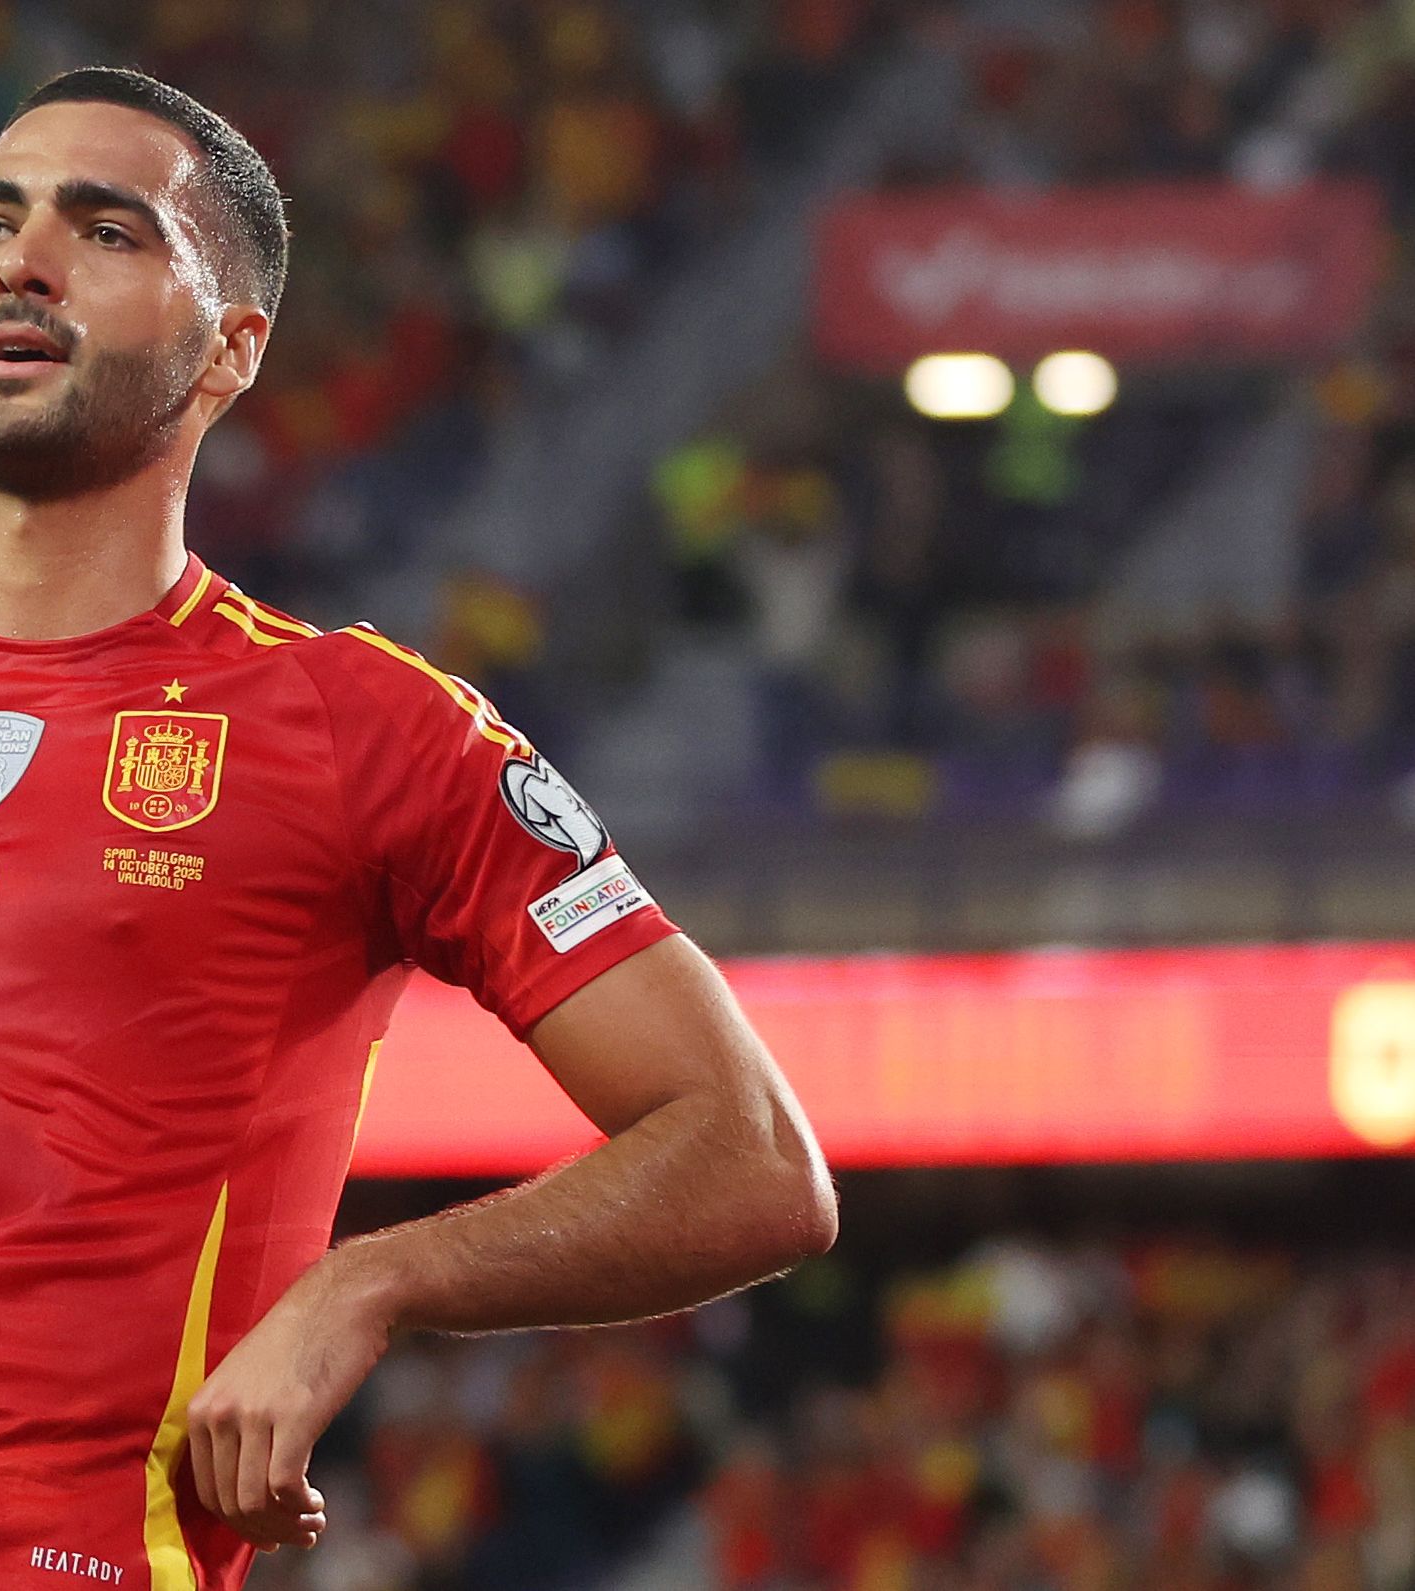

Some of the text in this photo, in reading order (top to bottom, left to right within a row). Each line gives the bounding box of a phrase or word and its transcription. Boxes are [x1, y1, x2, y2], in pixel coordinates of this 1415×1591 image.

[104, 847, 137, 860] SPAIN
[148, 850, 204, 869] BULGARIA
[103, 859, 202, 881] 14 OCTOBER 2025
[117, 871, 185, 891] VALLADOLID
[534, 896, 561, 917] UEFA
[30, 1546, 124, 1585] HEAT.RDY
